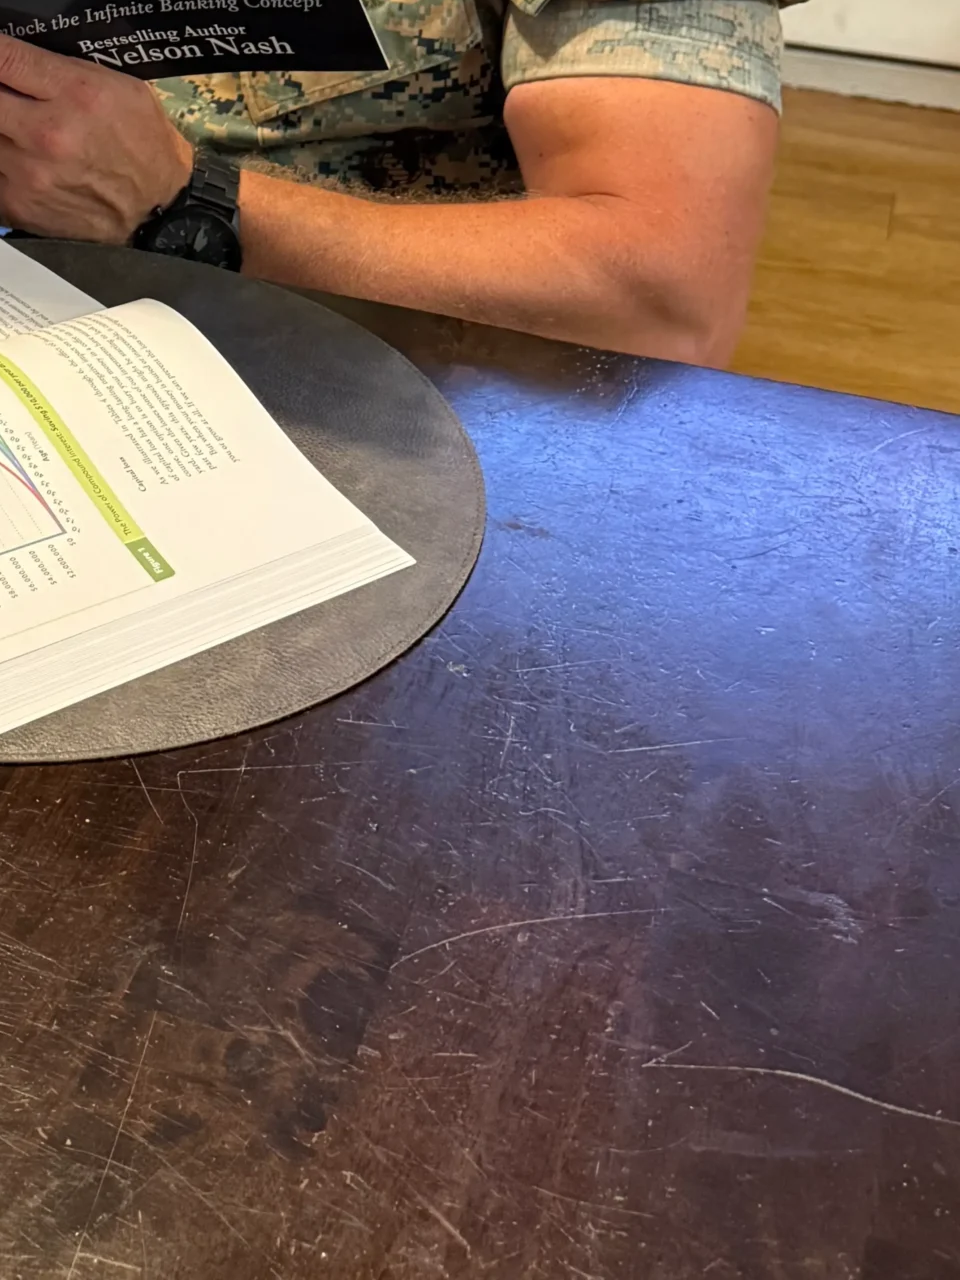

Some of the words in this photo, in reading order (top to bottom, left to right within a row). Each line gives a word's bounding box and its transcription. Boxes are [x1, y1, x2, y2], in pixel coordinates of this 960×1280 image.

[51, 14, 81, 31] the
[84, 0, 154, 24] Infinite
[77, 25, 178, 54] Bestselling
[183, 23, 247, 39] Author
[89, 42, 204, 67] Nelson
[208, 36, 295, 56] Nash
[40, 410, 58, 431] Saving
[55, 431, 76, 457] Interest:
[38, 449, 49, 461] Age
[119, 456, 130, 468] loss
[72, 458, 101, 493] Compound
[126, 469, 146, 491] Capital
[104, 502, 122, 522] Power
[120, 523, 131, 535] The
[143, 552, 163, 573] Figure
